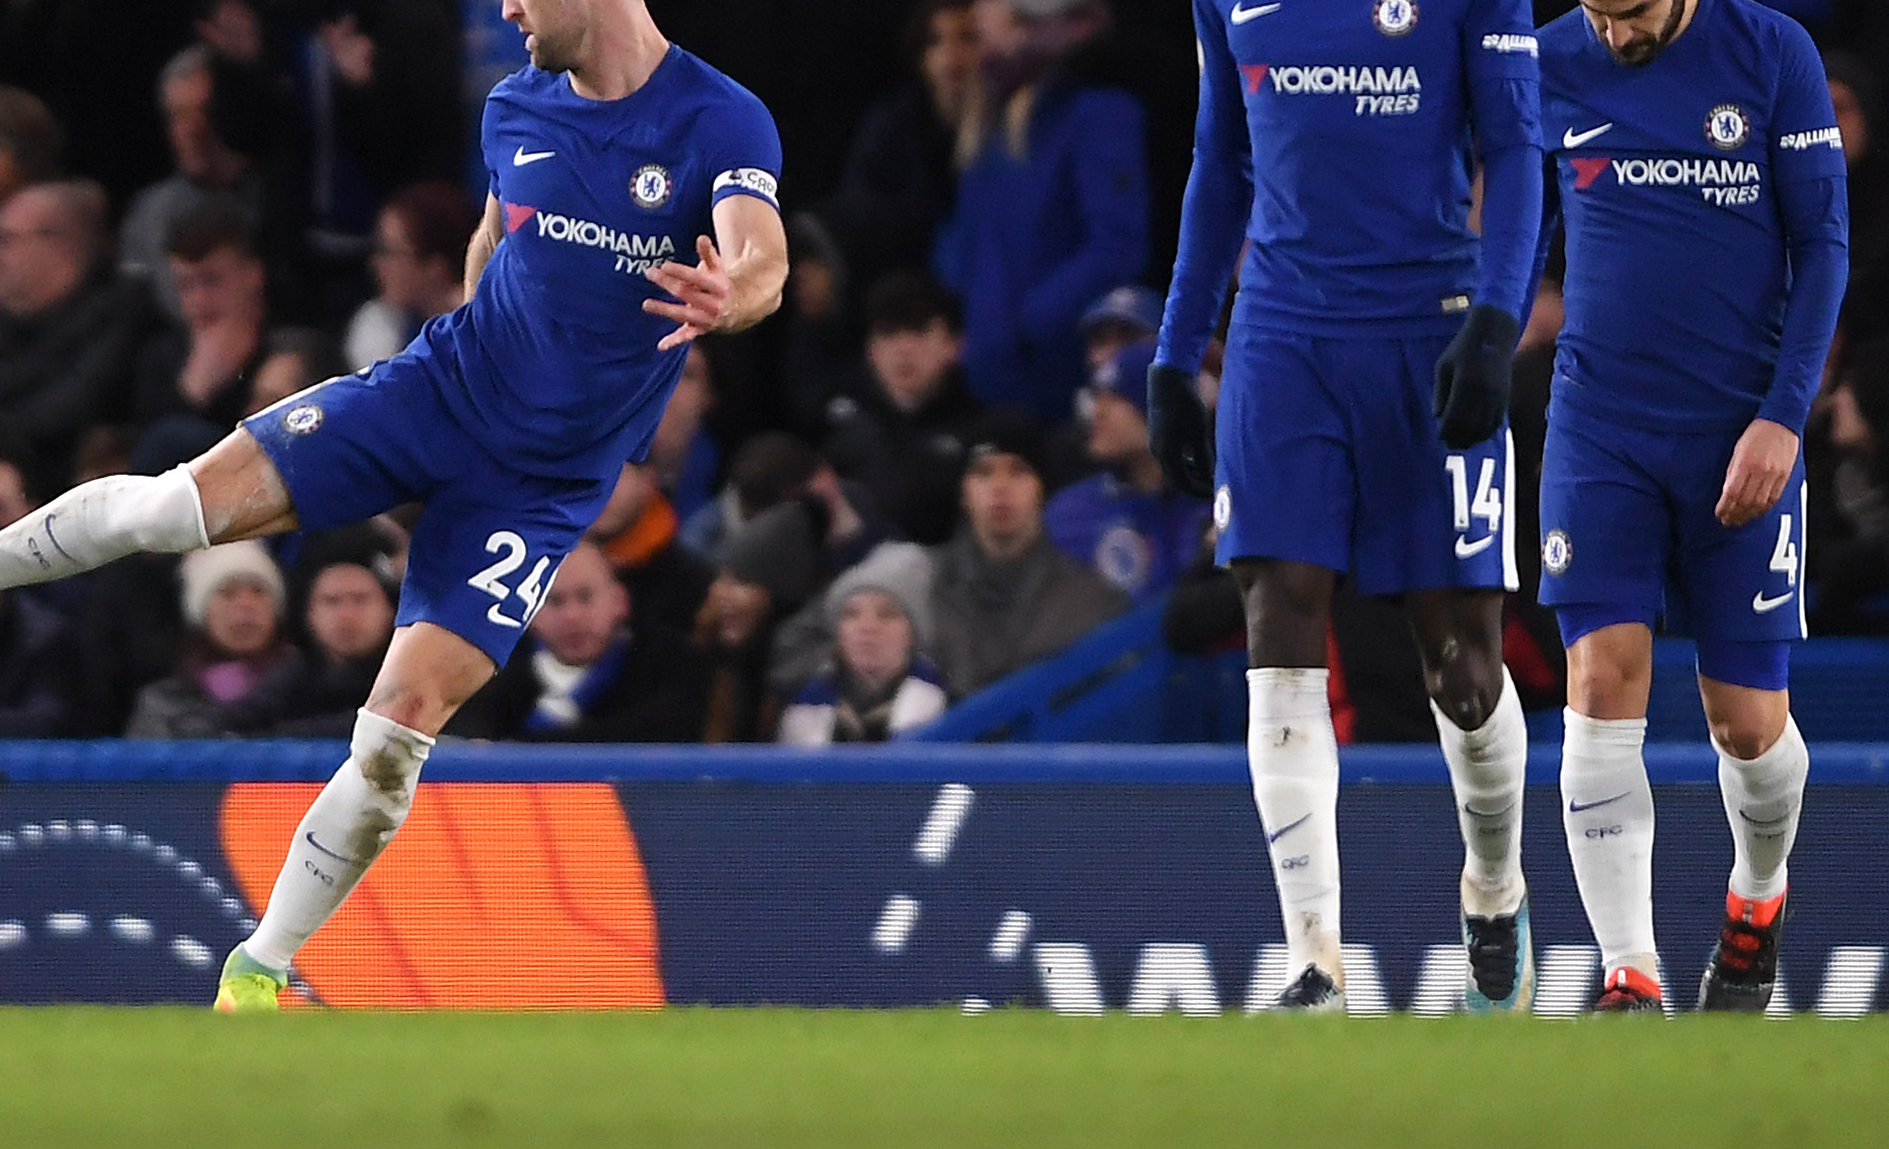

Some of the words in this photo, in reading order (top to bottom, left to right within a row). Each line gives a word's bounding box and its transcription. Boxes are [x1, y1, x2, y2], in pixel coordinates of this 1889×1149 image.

[1268, 64, 1422, 95] YOKOHAMA
[1354, 93, 1421, 117] TYRES
[1611, 158, 1761, 186] YOKOHAMA
[1701, 183, 1760, 206] TYRES
[536, 209, 676, 257] YOKOHAMA
[1445, 455, 1502, 532] 14
[1769, 513, 1798, 587] 4
[467, 530, 551, 623] 24
[1585, 824, 1623, 839] CFC
